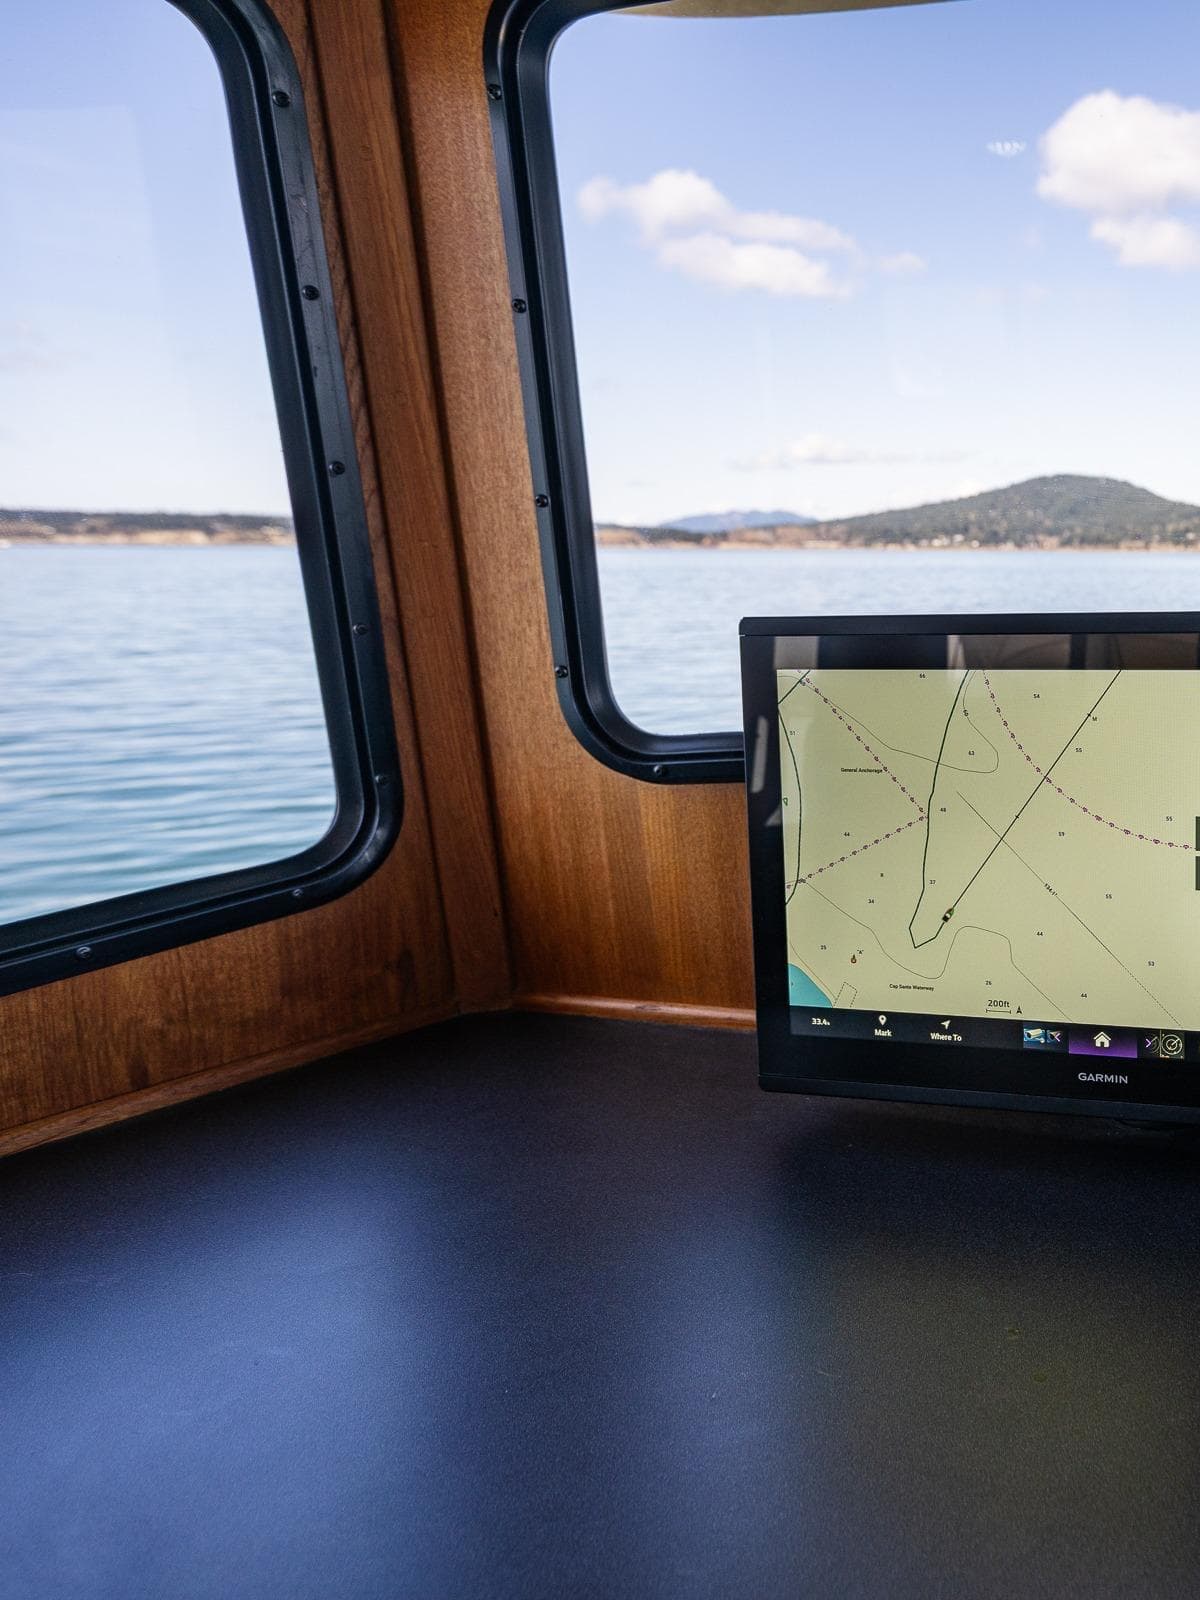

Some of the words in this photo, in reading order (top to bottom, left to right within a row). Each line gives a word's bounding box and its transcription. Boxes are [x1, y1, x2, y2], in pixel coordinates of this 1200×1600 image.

[987, 999, 1010, 1009] 200ft
[874, 1028, 892, 1037] Mark
[930, 1032, 952, 1041] Where
[951, 1033, 962, 1042] To
[1078, 1072, 1128, 1084] GARMIN
